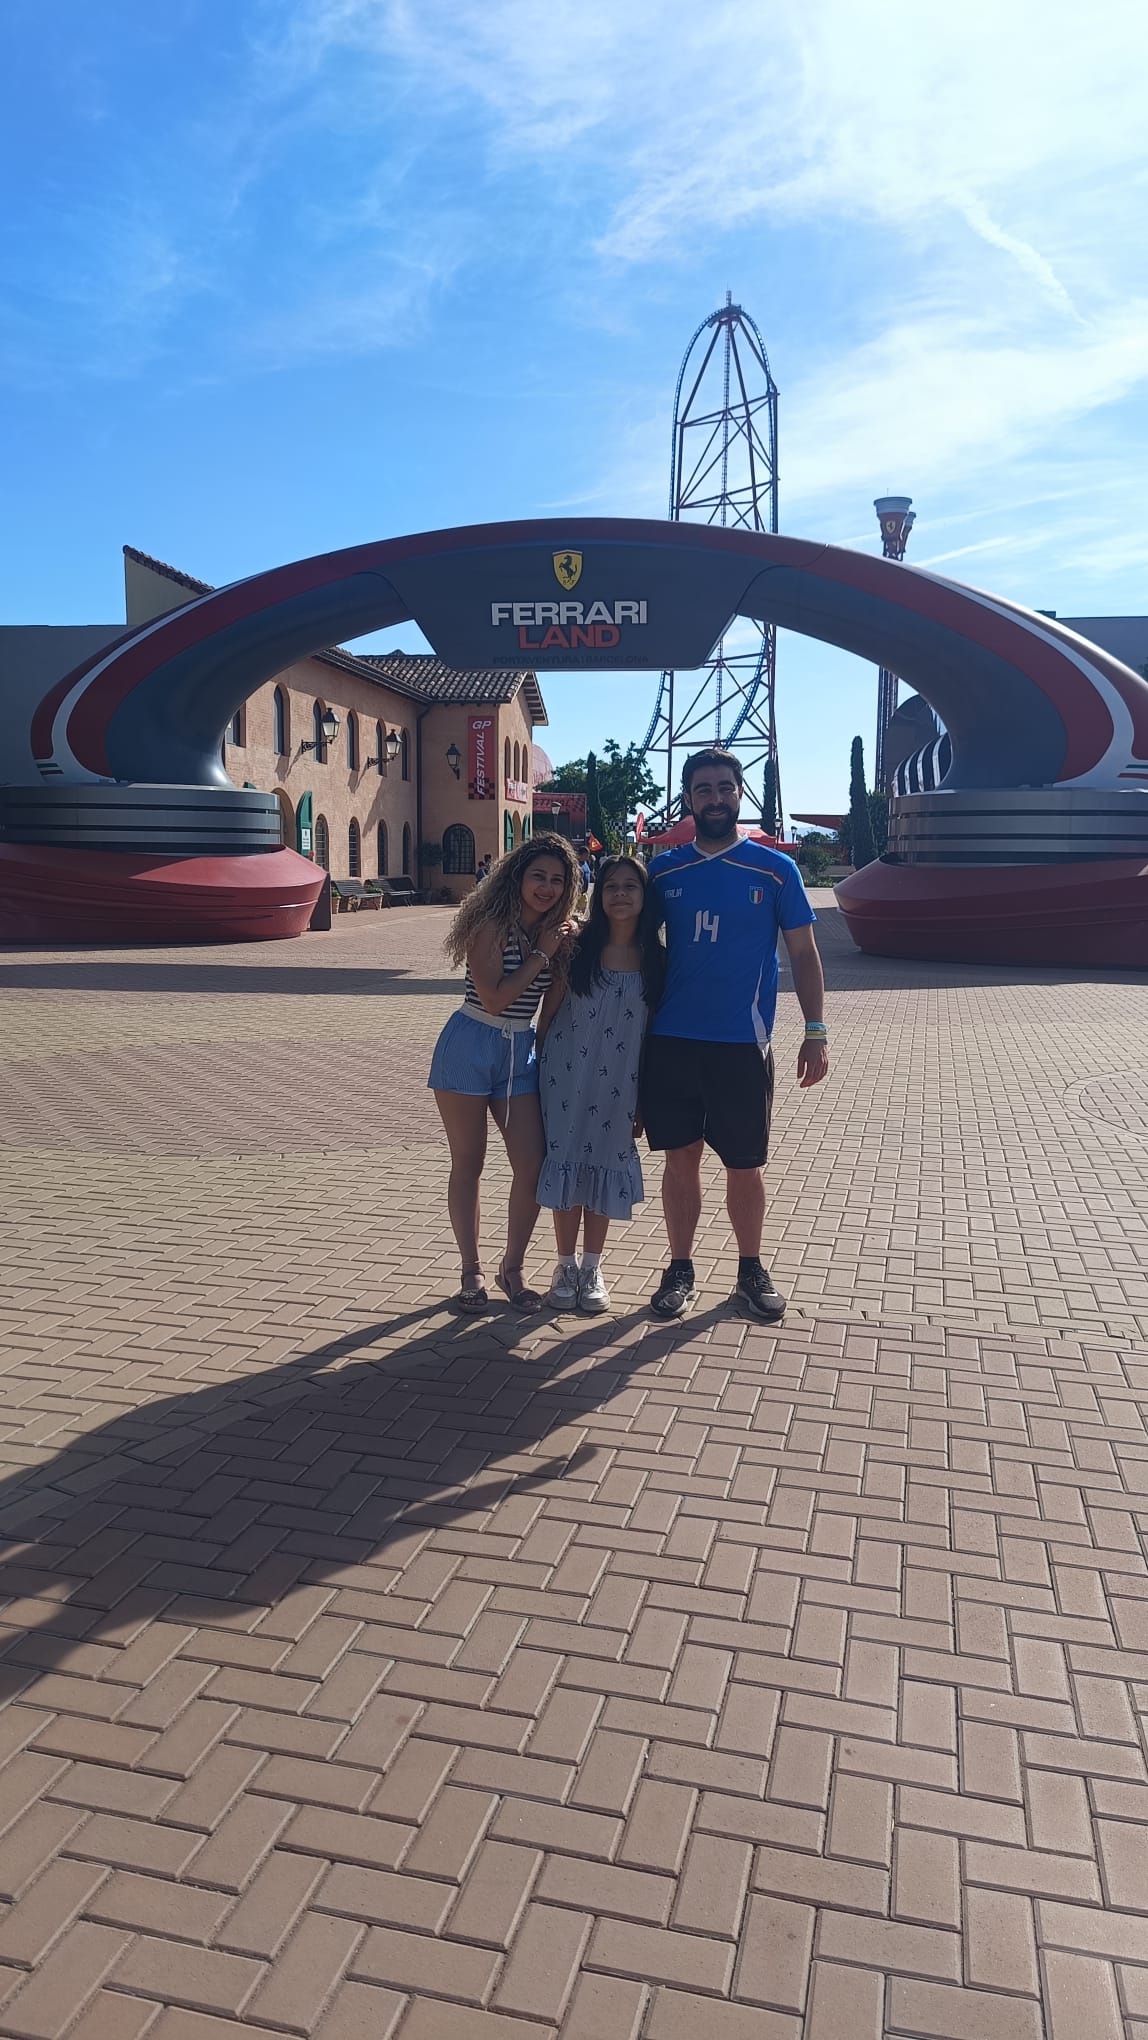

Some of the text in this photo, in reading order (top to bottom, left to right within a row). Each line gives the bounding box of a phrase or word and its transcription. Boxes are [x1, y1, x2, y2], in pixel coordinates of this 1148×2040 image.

[491, 601, 647, 626] FERRARI
[519, 625, 621, 649] LAND
[472, 720, 492, 730] GP
[476, 731, 485, 797] FESTIVAL
[693, 910, 720, 942] 14
